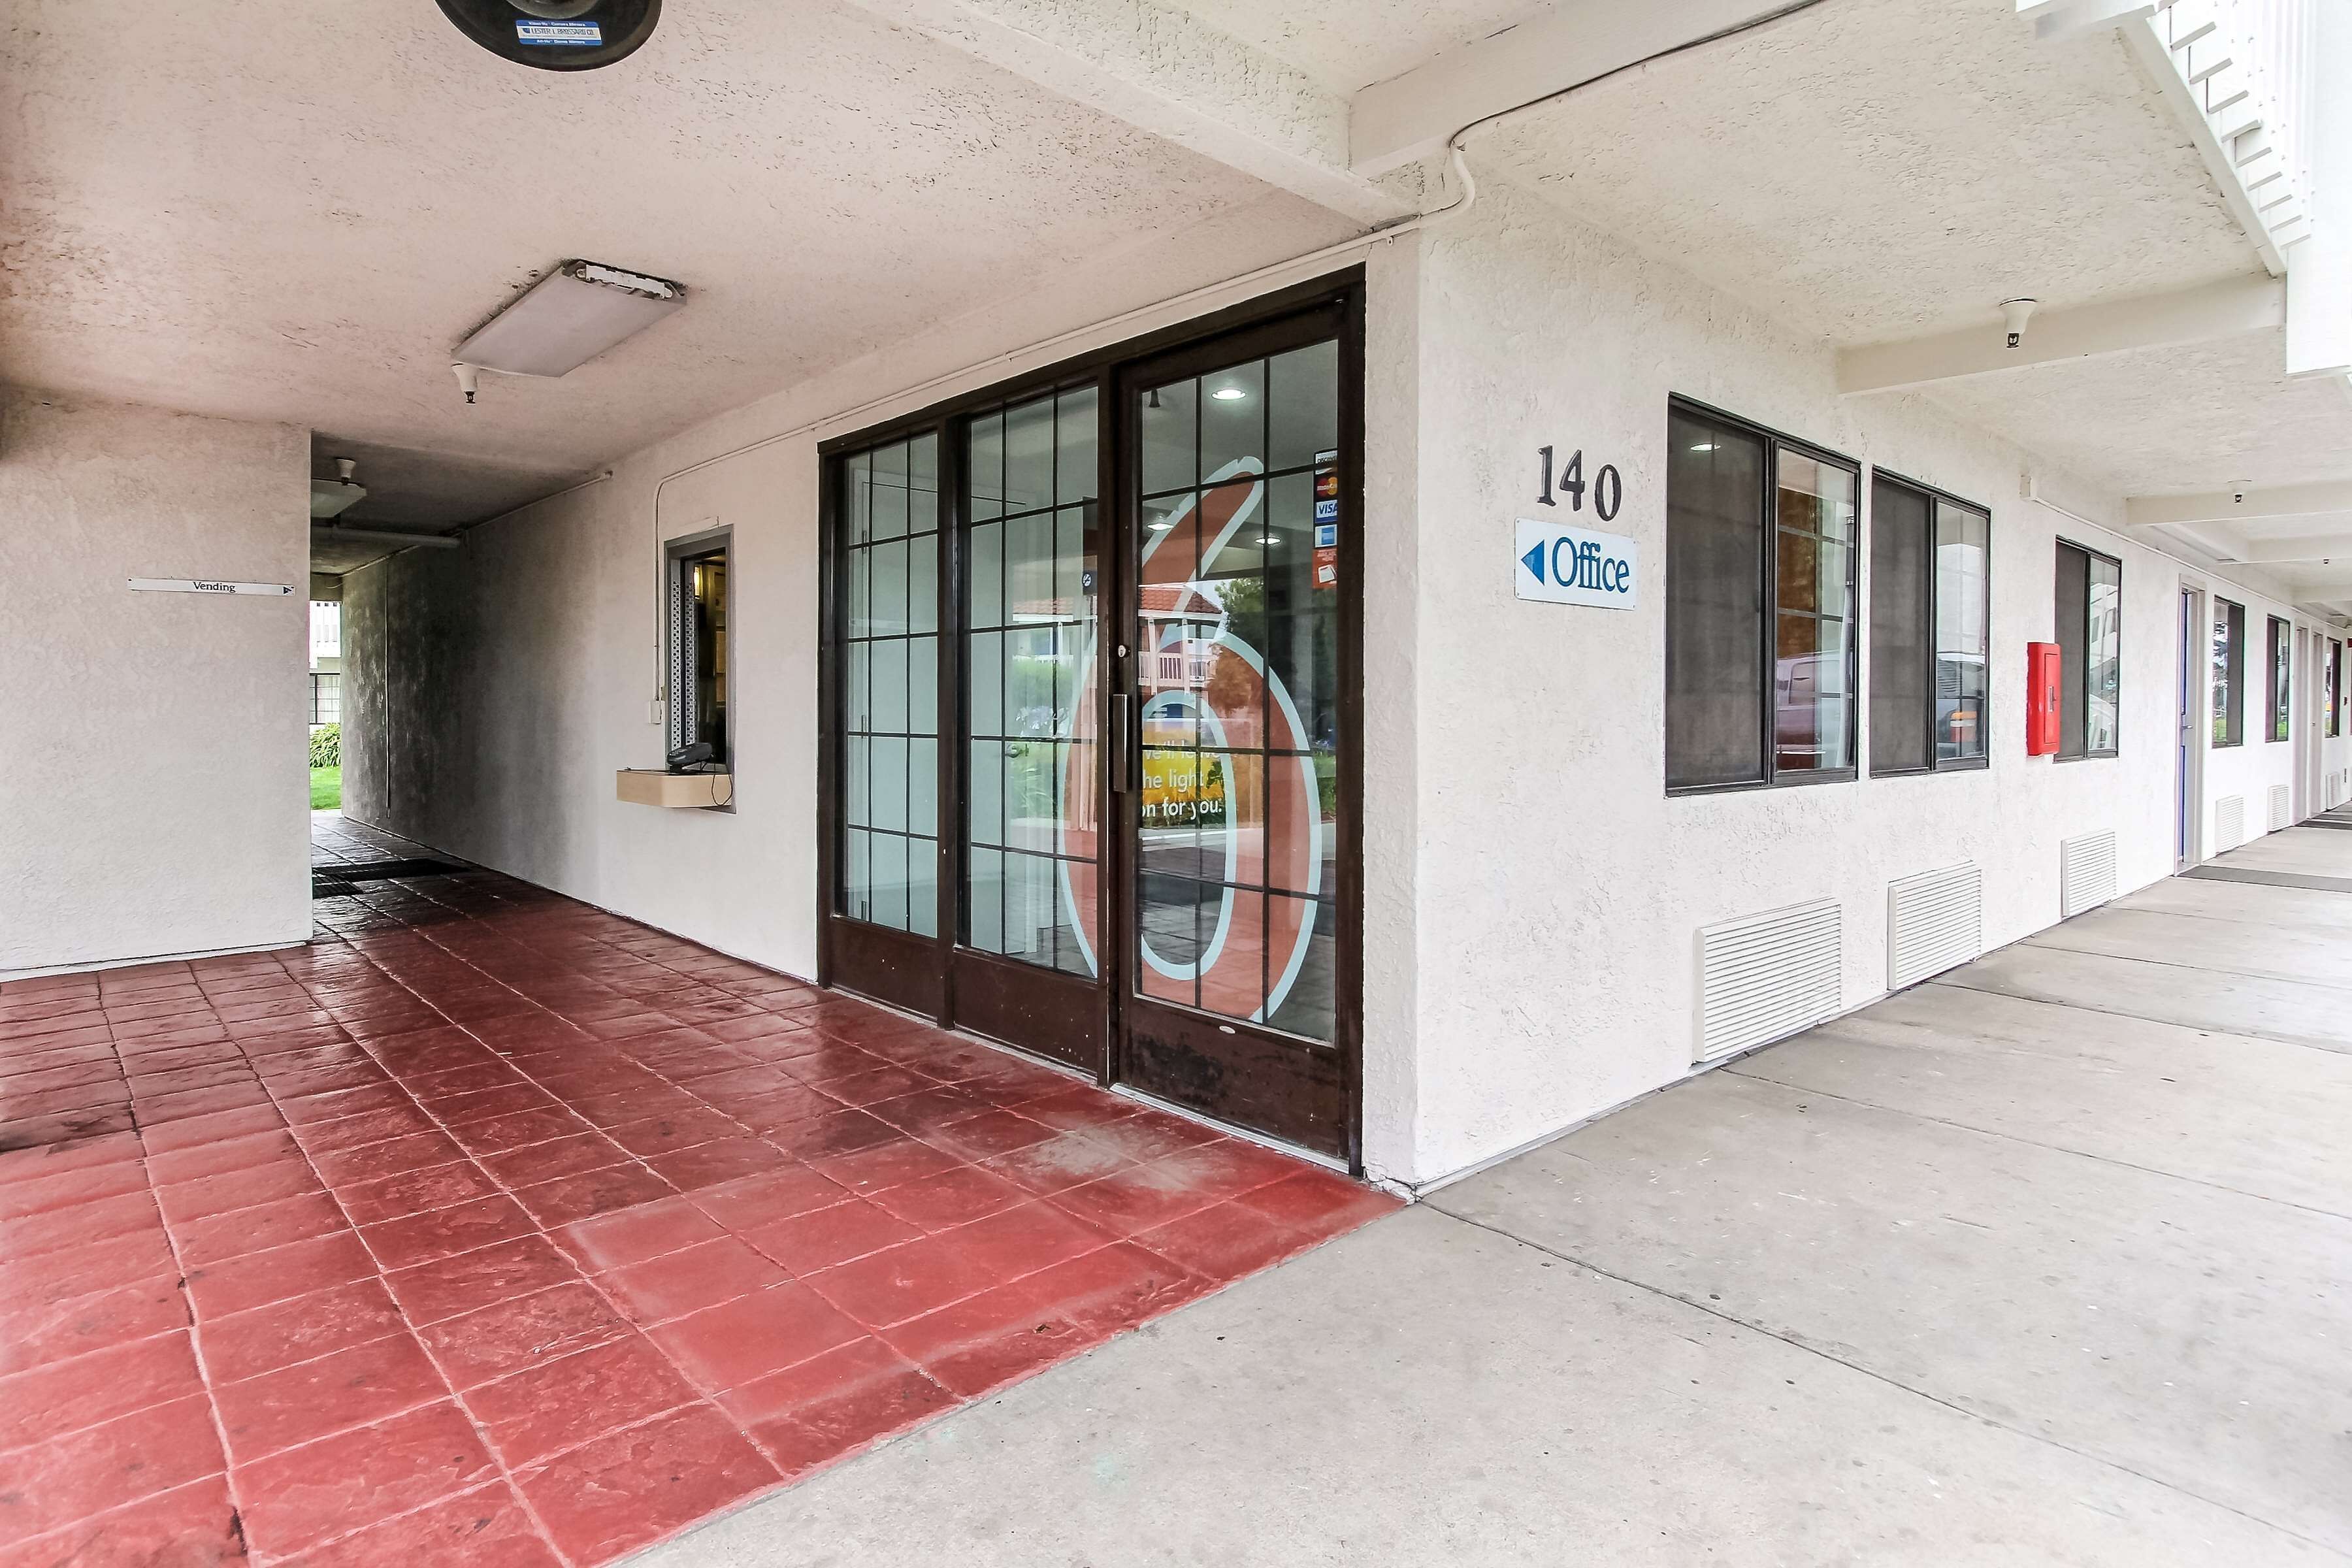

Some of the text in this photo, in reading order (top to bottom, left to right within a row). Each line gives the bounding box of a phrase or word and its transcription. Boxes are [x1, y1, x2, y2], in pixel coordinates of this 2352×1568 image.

[1537, 445, 1622, 521] 140
[1552, 536, 1629, 593] Office
[193, 581, 236, 593] Vending
[1182, 740, 1220, 759] leve
[1142, 768, 1205, 792] he light
[1162, 796, 1186, 816] for
